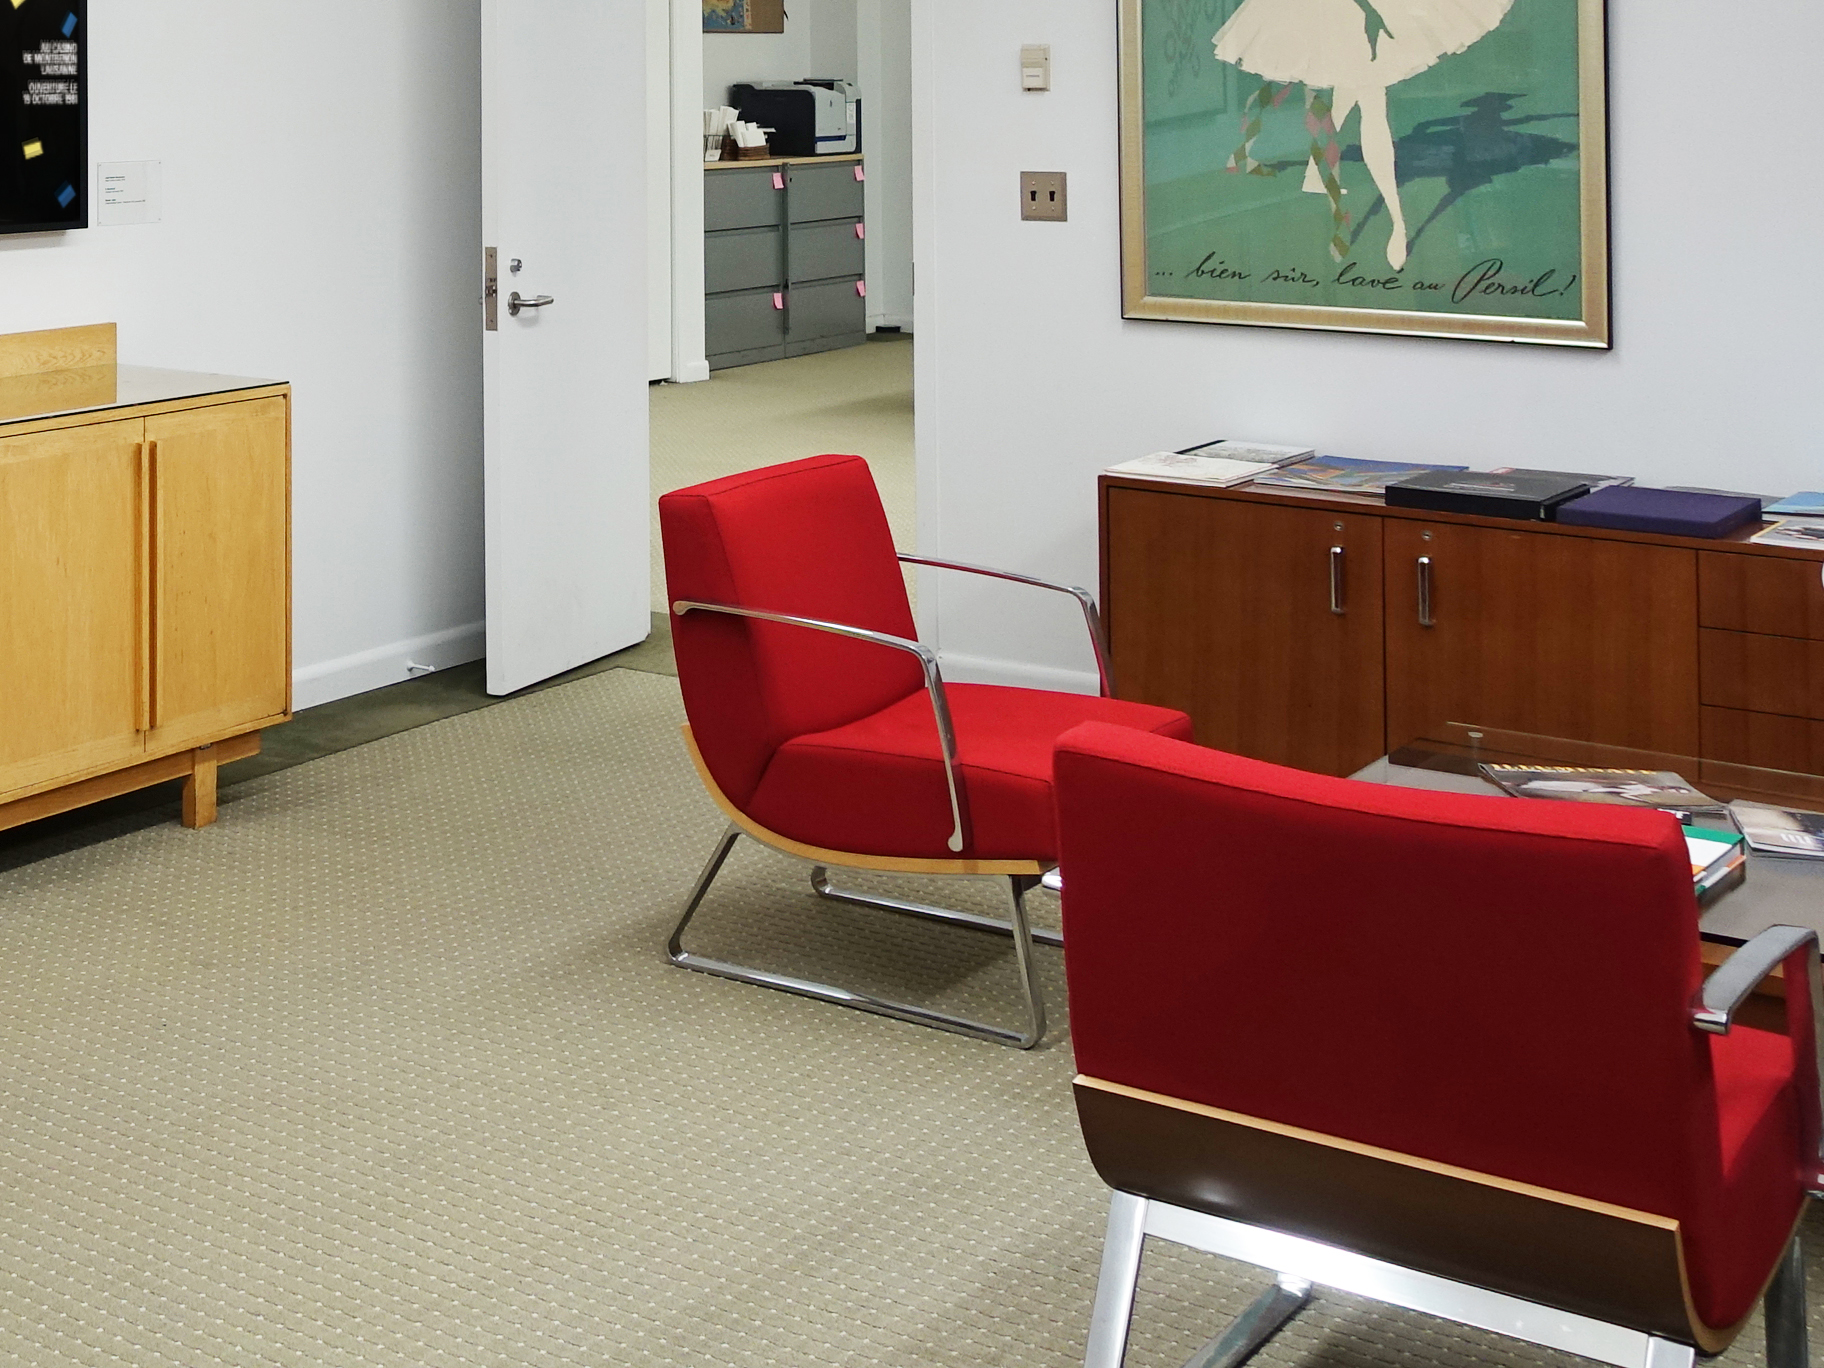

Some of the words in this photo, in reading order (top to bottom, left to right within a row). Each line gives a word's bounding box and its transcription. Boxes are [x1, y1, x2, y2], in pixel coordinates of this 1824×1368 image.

[1185, 250, 1251, 280] bien
[1333, 261, 1405, 290] lavé
[1411, 282, 1445, 291] au
